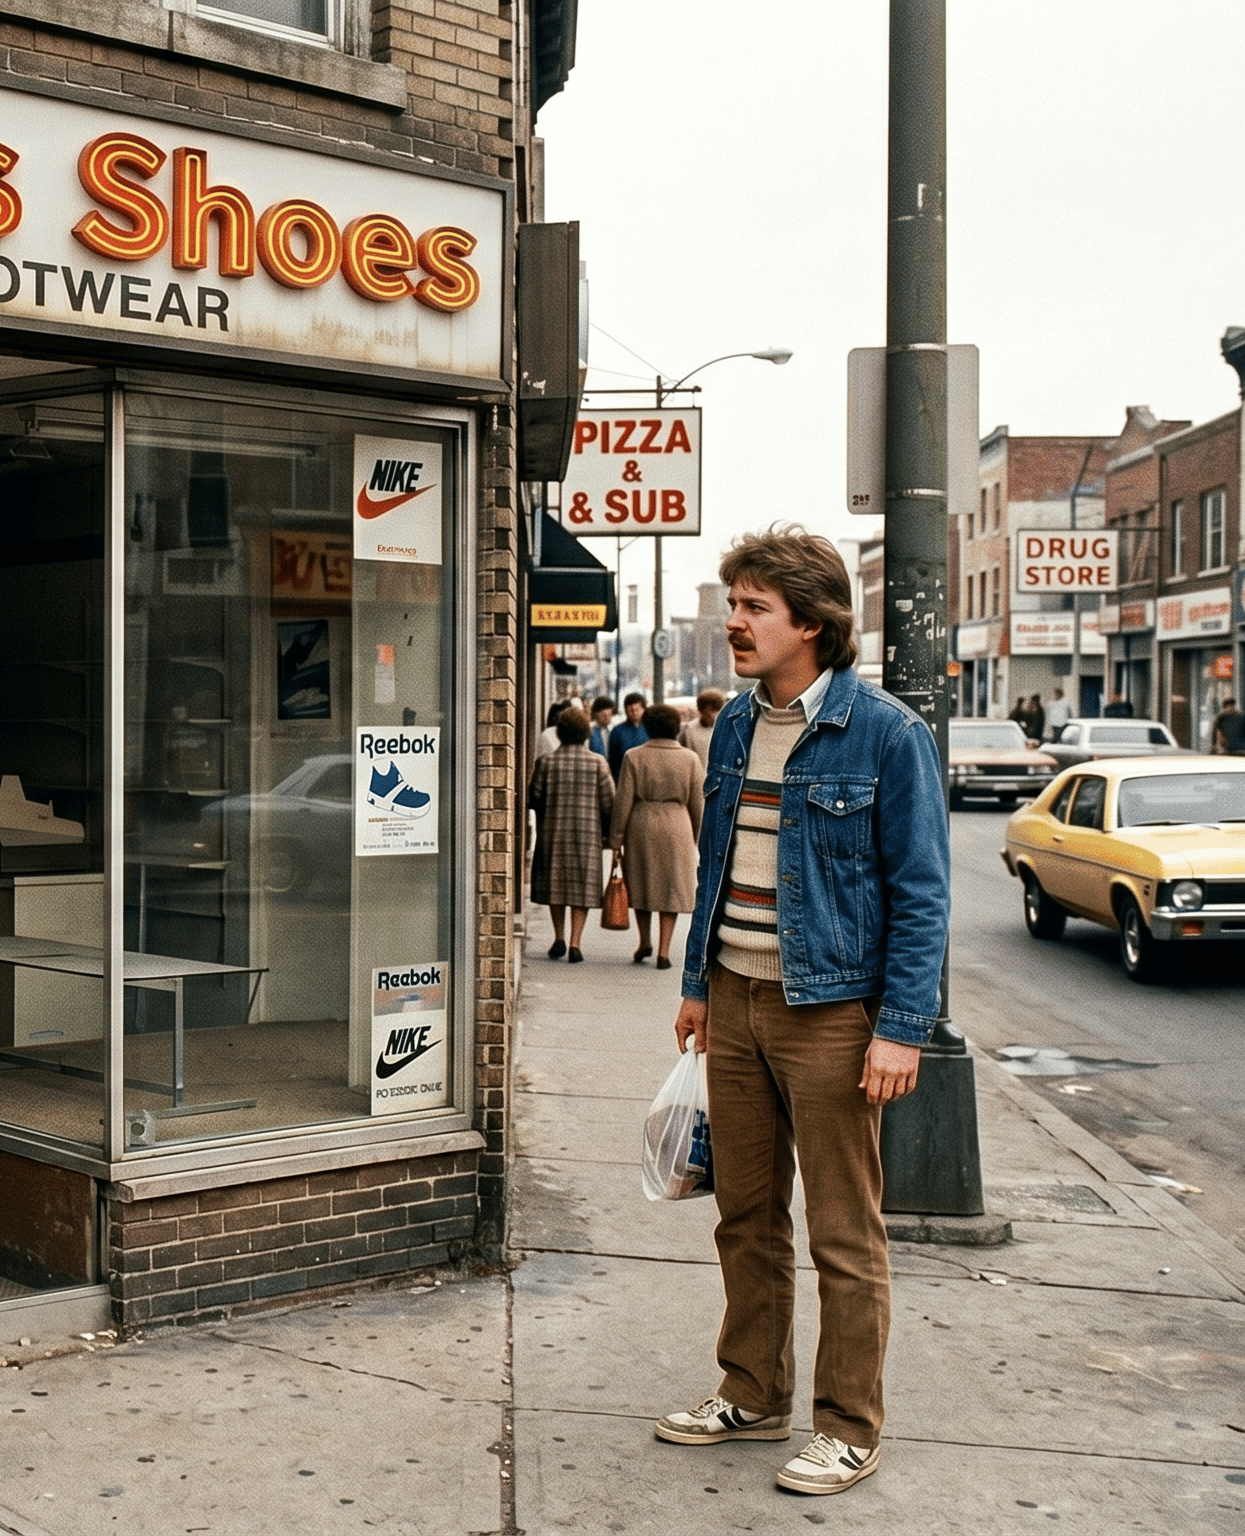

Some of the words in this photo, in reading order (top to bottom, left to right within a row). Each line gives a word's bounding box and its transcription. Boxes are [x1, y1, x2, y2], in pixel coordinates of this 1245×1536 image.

[71, 132, 481, 313] Shoes
[573, 419, 691, 454] PIZZA
[369, 459, 423, 493] NIKE
[622, 460, 642, 482] &
[569, 491, 593, 524] &
[604, 489, 686, 524] SUB
[1026, 537, 1110, 559] DRUG
[1025, 565, 1111, 586] STORE
[360, 734, 436, 759] Reebok
[384, 1025, 432, 1057] NIKE
